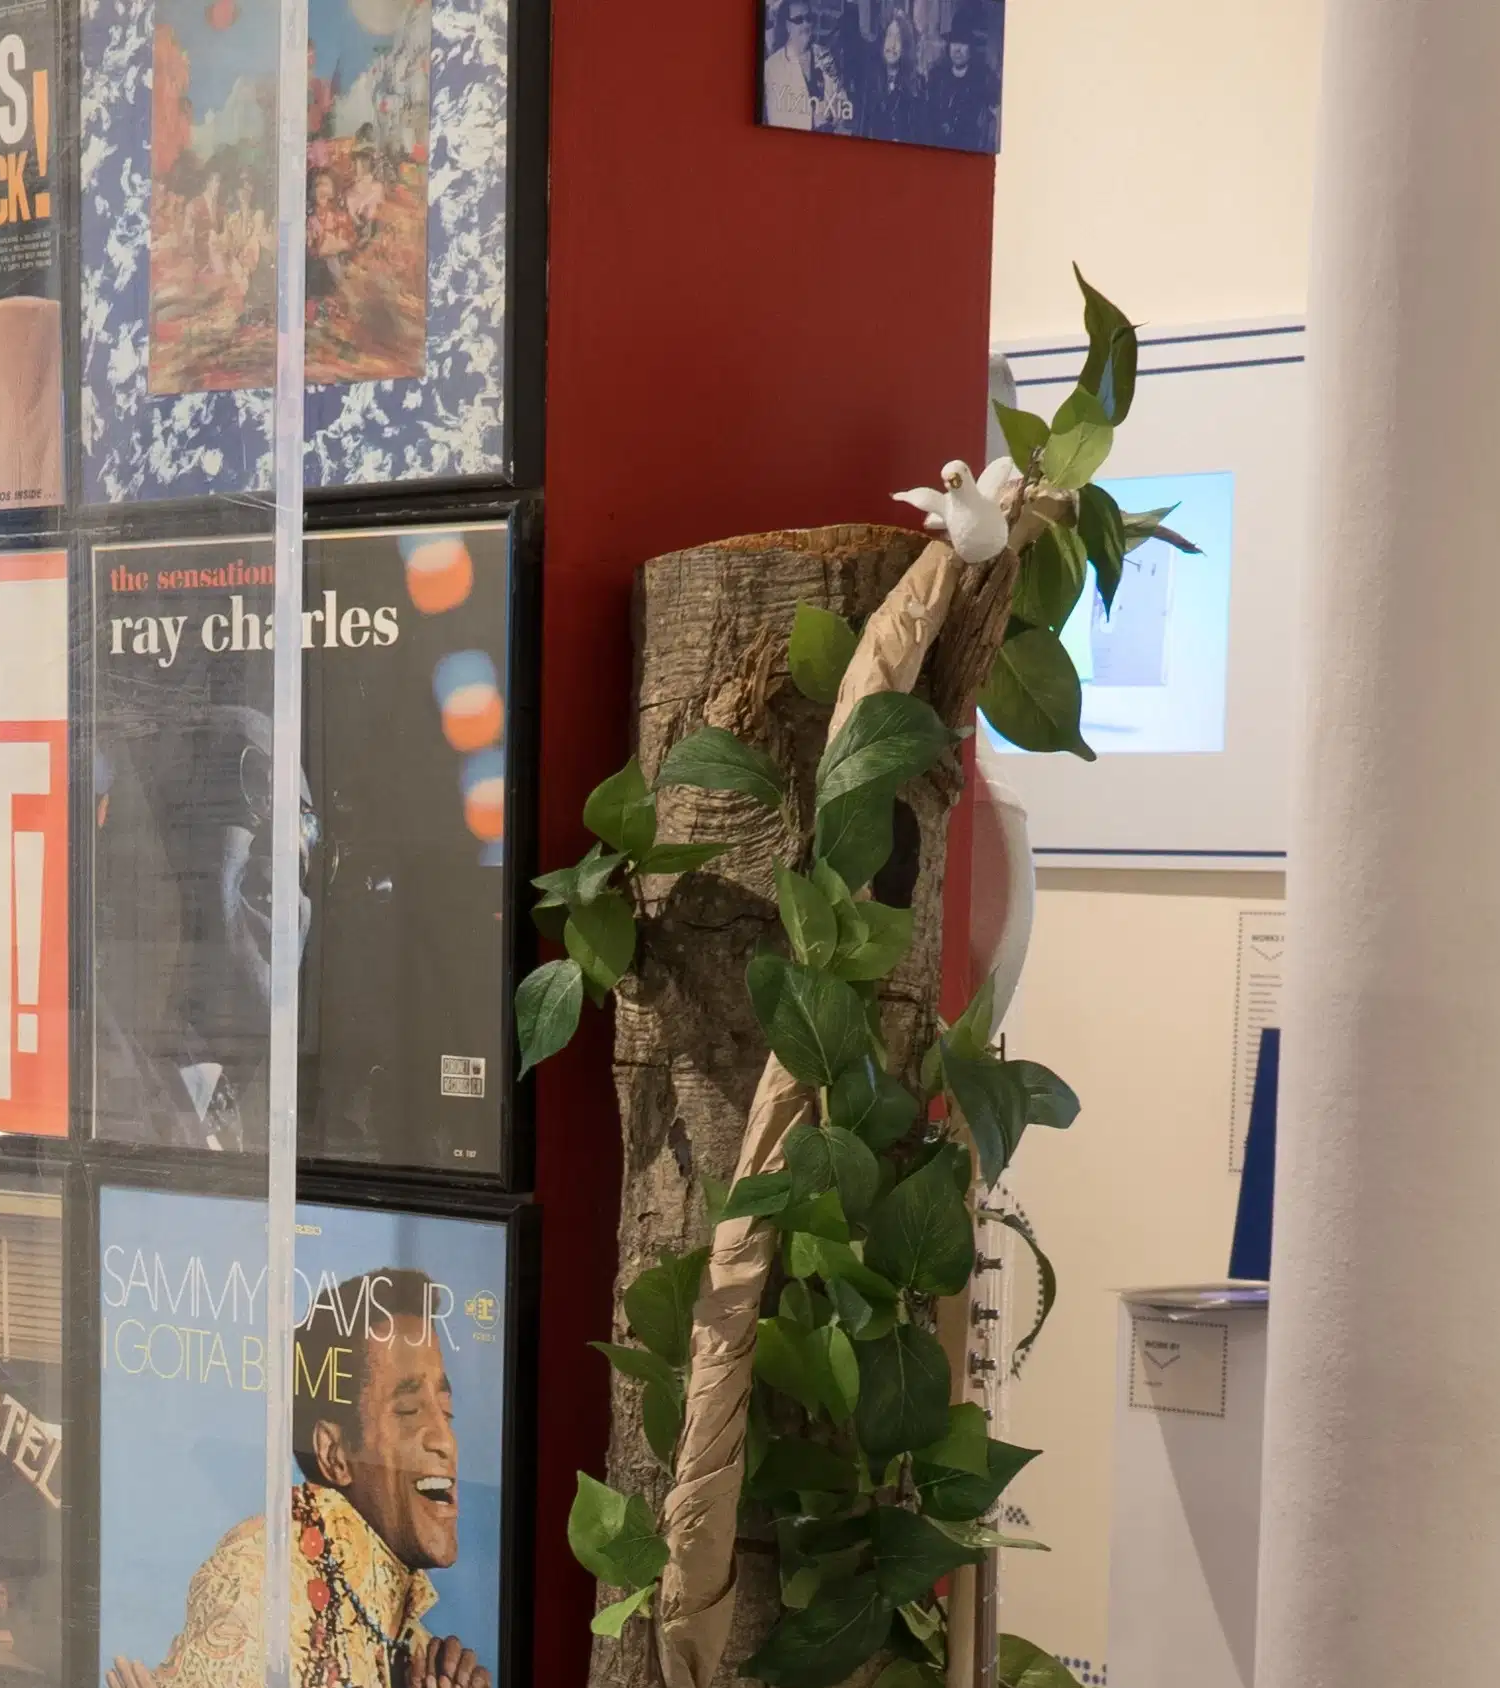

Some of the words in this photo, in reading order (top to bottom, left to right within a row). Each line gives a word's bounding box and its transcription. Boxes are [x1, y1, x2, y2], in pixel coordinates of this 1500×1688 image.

[824, 91, 853, 120] Xia
[14, 487, 42, 501] INSIDE
[110, 563, 149, 593] the
[157, 558, 276, 590] sensation
[110, 615, 188, 668] ray
[103, 1244, 268, 1325] SAMMY
[404, 1282, 461, 1353] JR.
[102, 1316, 109, 1370] I
[115, 1318, 233, 1389] GOTTA
[295, 1341, 353, 1404] ME
